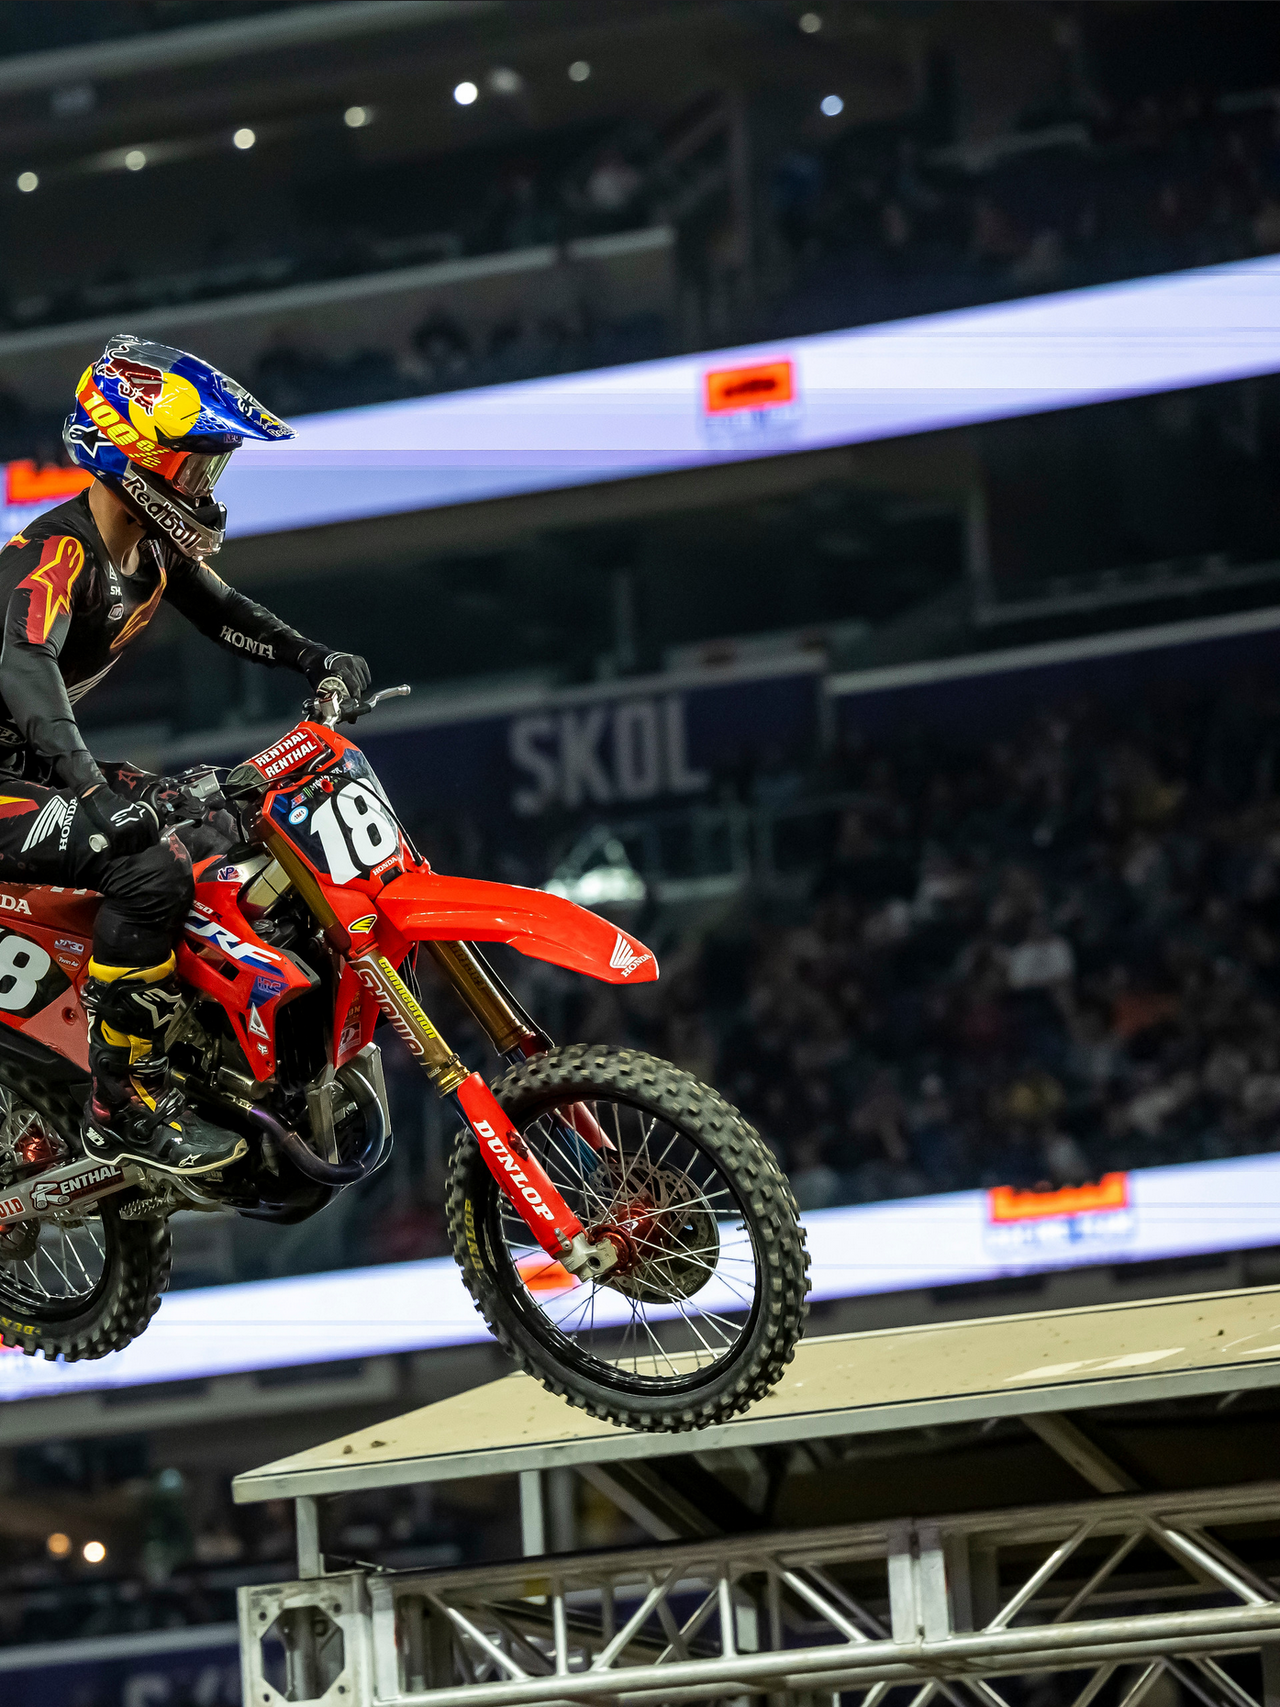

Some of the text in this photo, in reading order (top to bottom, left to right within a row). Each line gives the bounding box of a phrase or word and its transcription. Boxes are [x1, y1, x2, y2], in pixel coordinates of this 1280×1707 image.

[254, 729, 309, 768] RENTHAL
[265, 740, 318, 777] RENTHAL
[508, 692, 711, 814] SKOL
[59, 797, 78, 851] HONDA
[310, 777, 397, 885] 18
[372, 856, 398, 876] HONDA
[621, 953, 652, 977] HONDA
[473, 1119, 555, 1222] DUNLOP
